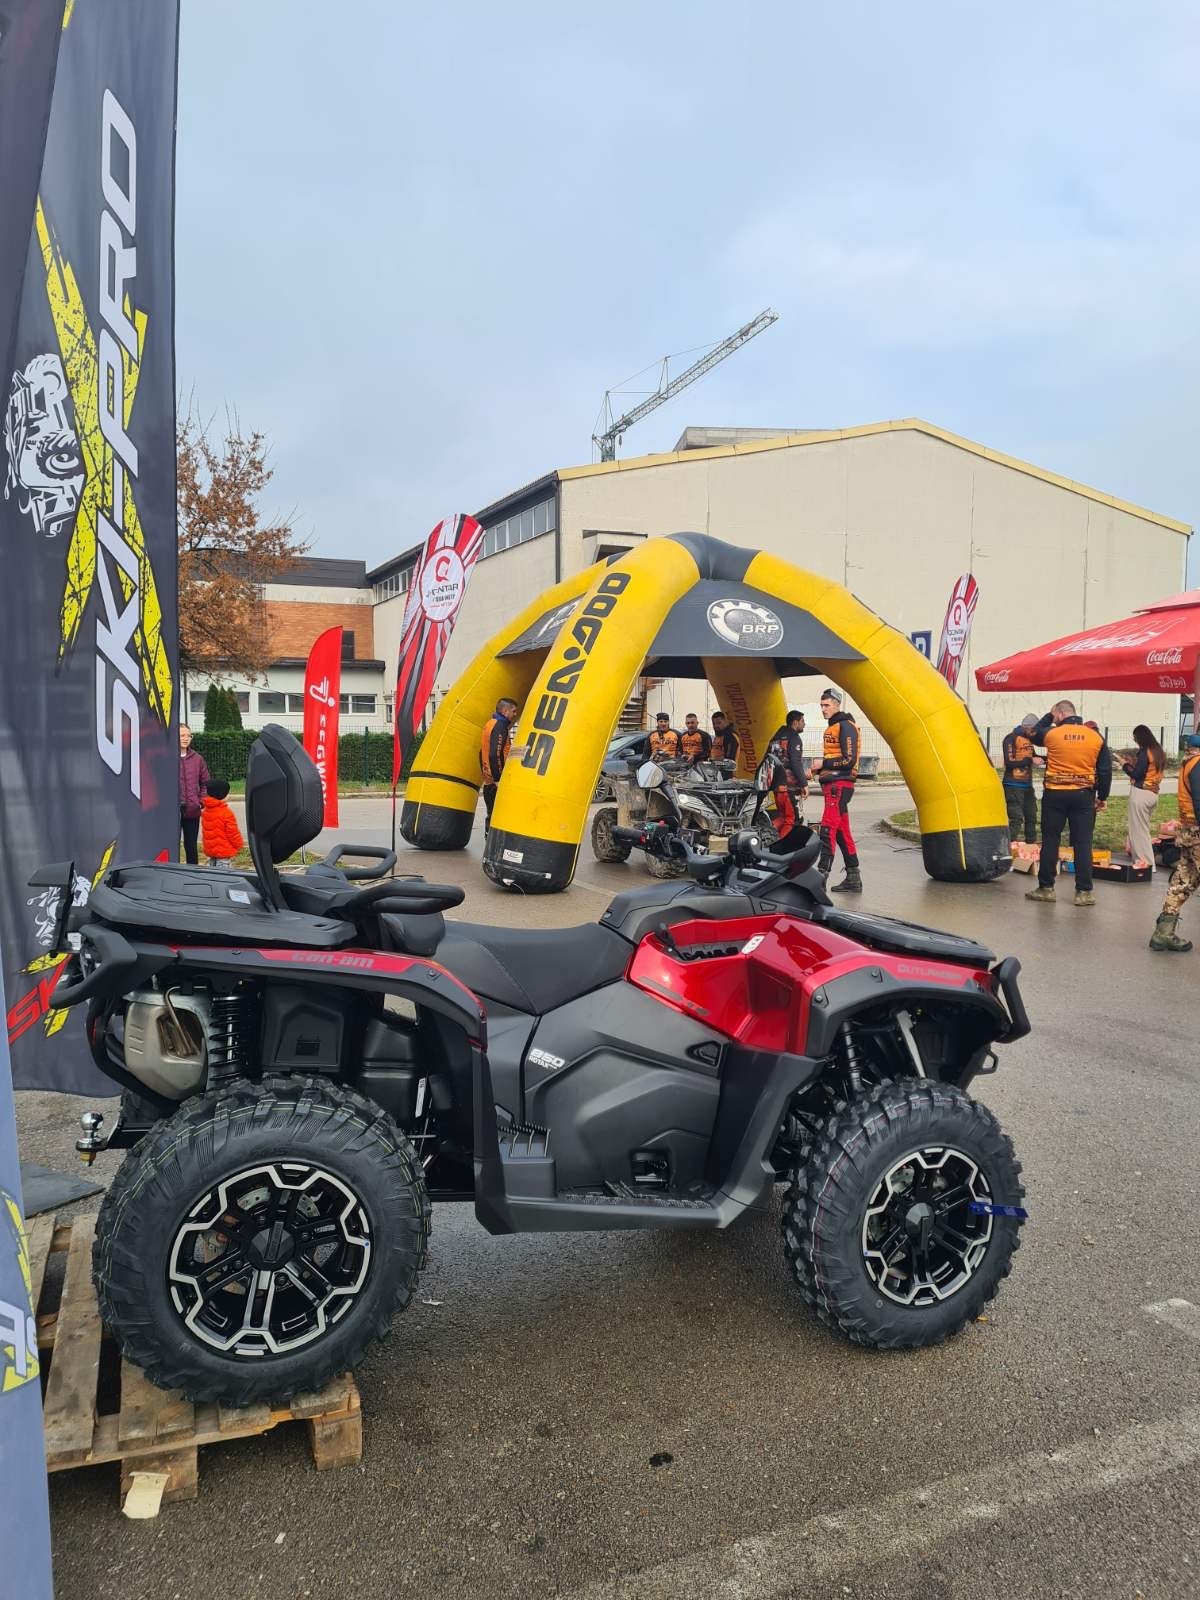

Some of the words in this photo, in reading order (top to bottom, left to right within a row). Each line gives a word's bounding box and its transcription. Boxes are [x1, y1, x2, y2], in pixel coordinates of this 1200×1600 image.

[95, 87, 141, 801] SKI-PRO
[741, 624, 780, 633] BRP
[739, 727, 758, 774] company
